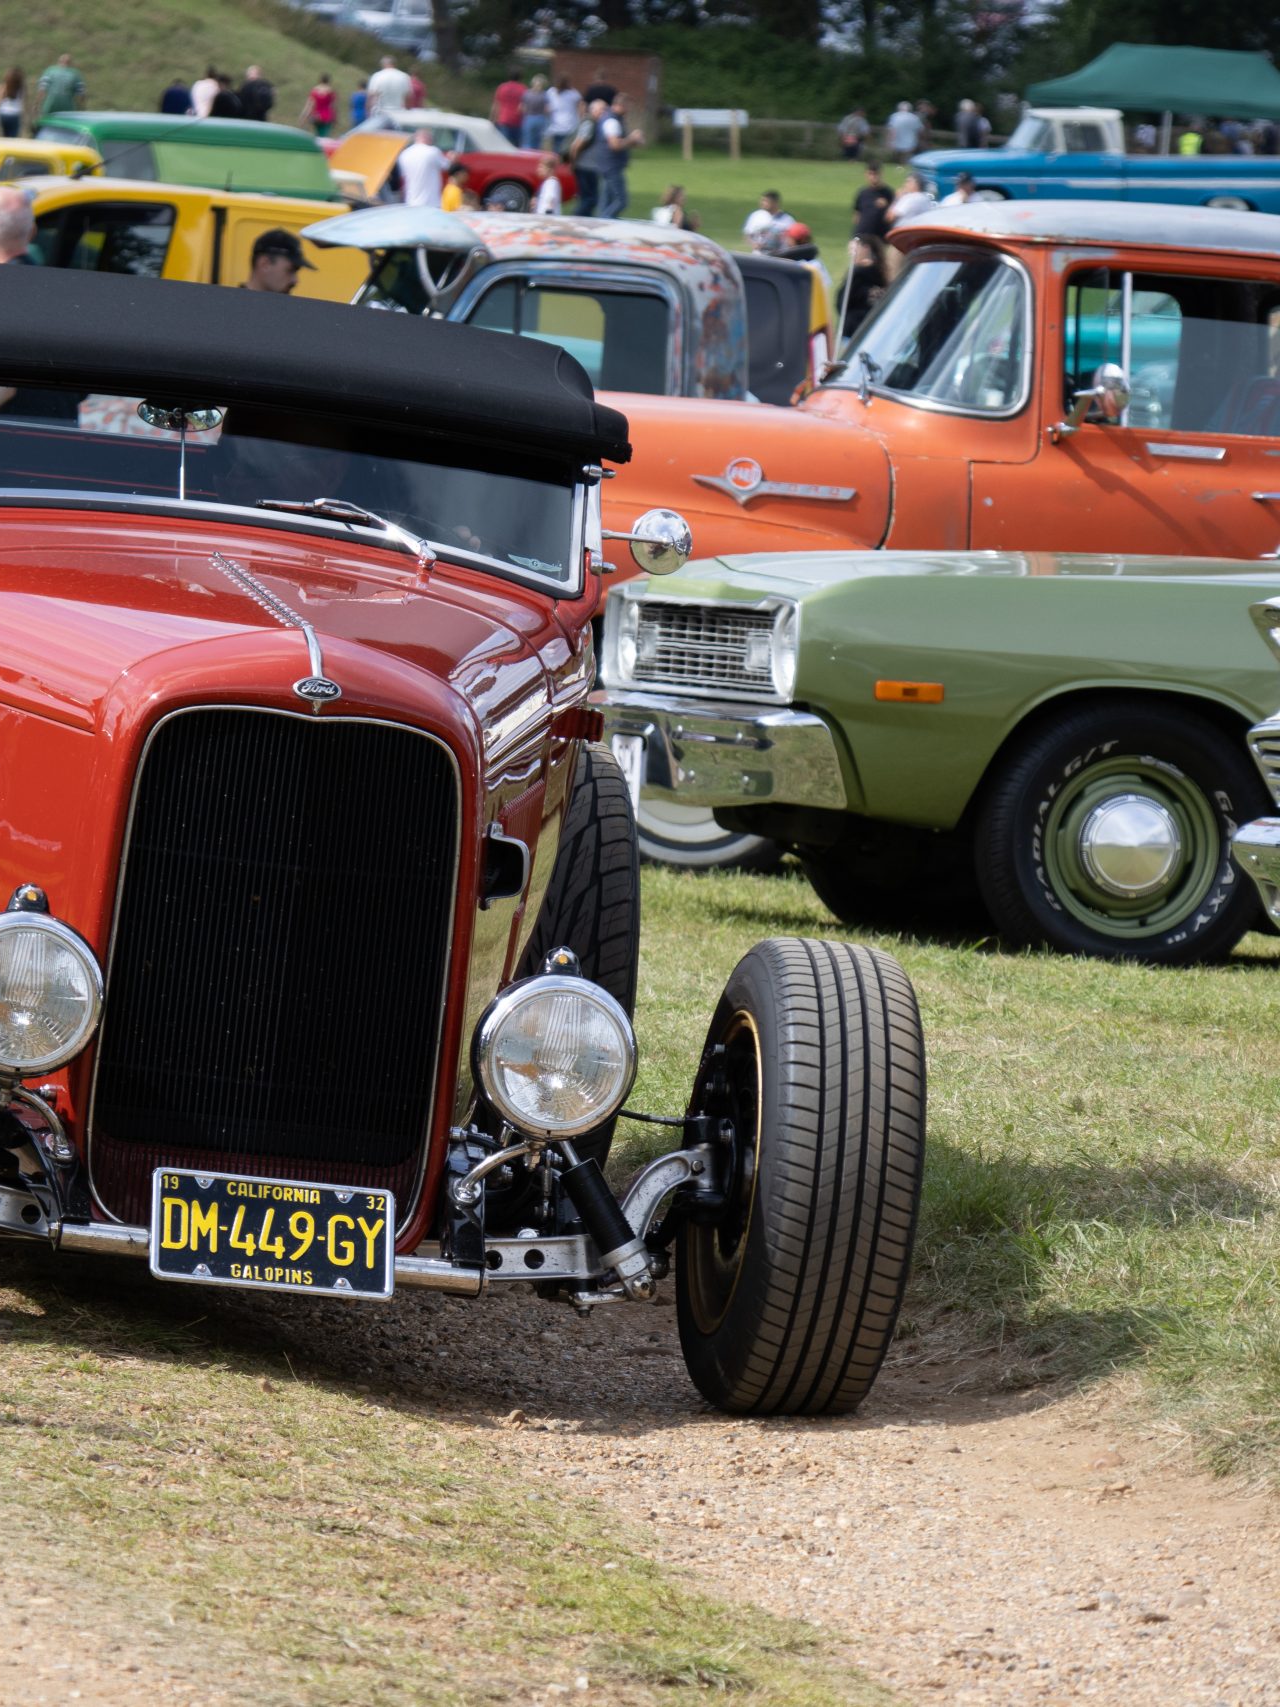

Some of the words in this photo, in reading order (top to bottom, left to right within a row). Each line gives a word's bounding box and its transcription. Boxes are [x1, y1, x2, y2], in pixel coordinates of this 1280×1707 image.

[300, 679, 336, 695] Ford
[162, 1174, 180, 1190] 19
[226, 1181, 321, 1205] CALIFORNIA
[365, 1195, 386, 1212] 32
[161, 1196, 385, 1270] DM-449-GY
[230, 1263, 314, 1286] GALOPINS
